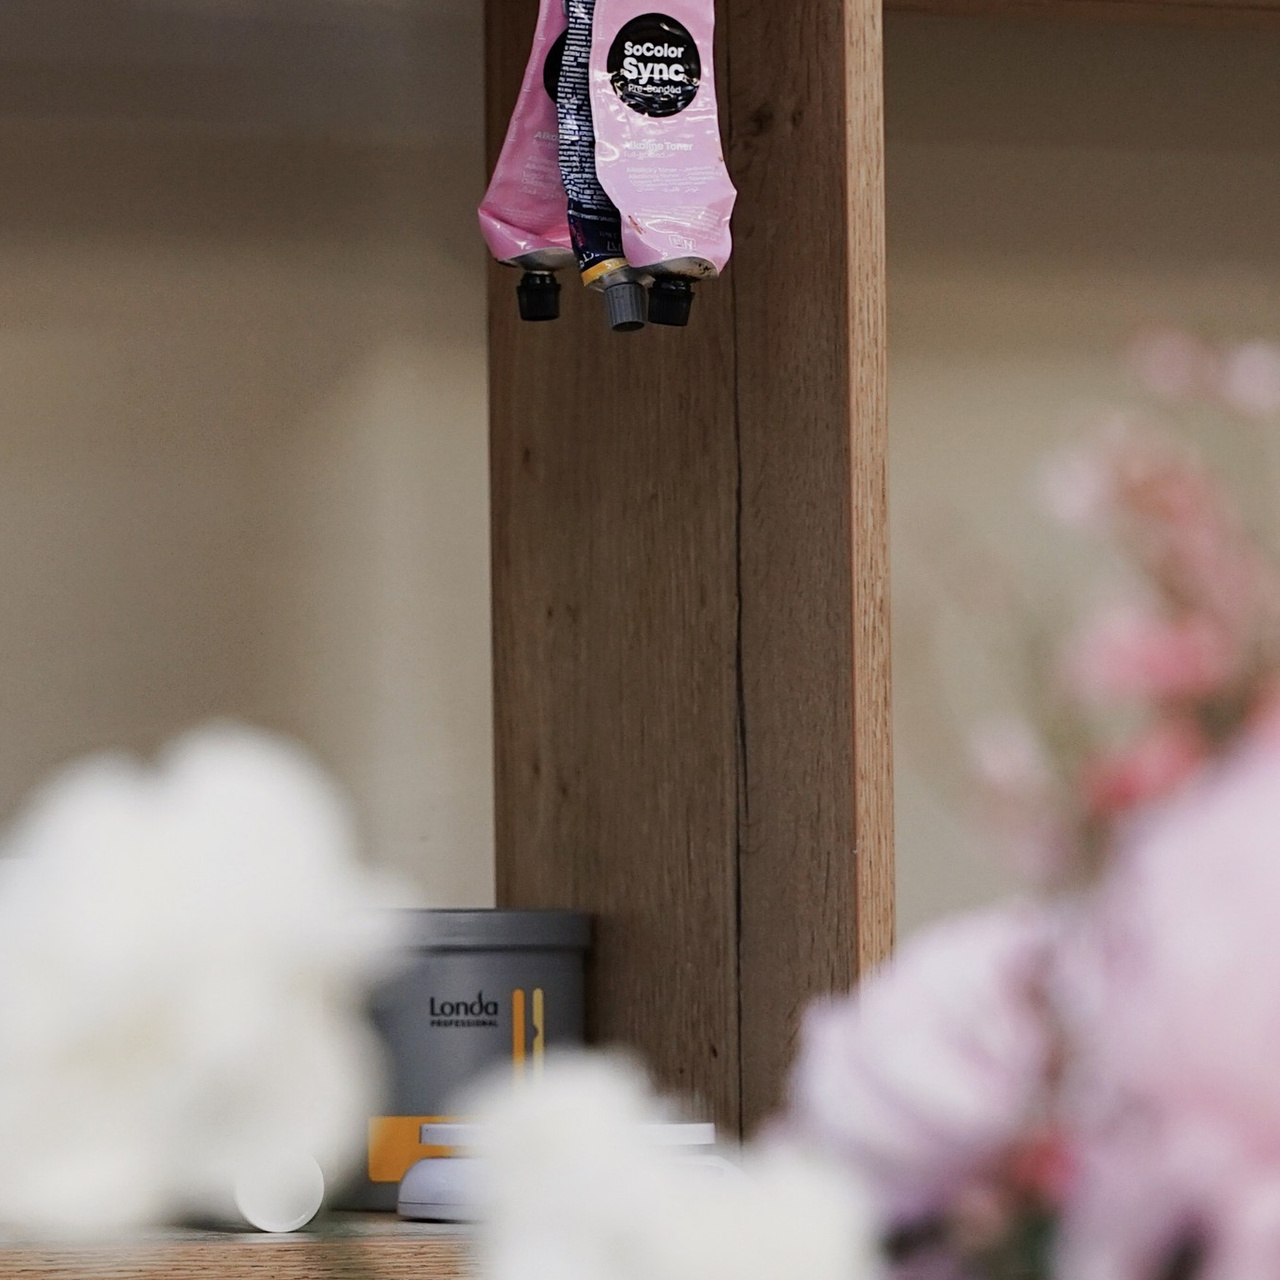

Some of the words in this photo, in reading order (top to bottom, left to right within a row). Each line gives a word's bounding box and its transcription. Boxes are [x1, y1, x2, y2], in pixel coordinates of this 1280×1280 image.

[624, 42, 683, 58] SoColor
[623, 58, 685, 82] Sync
[430, 991, 498, 1016] Londa
